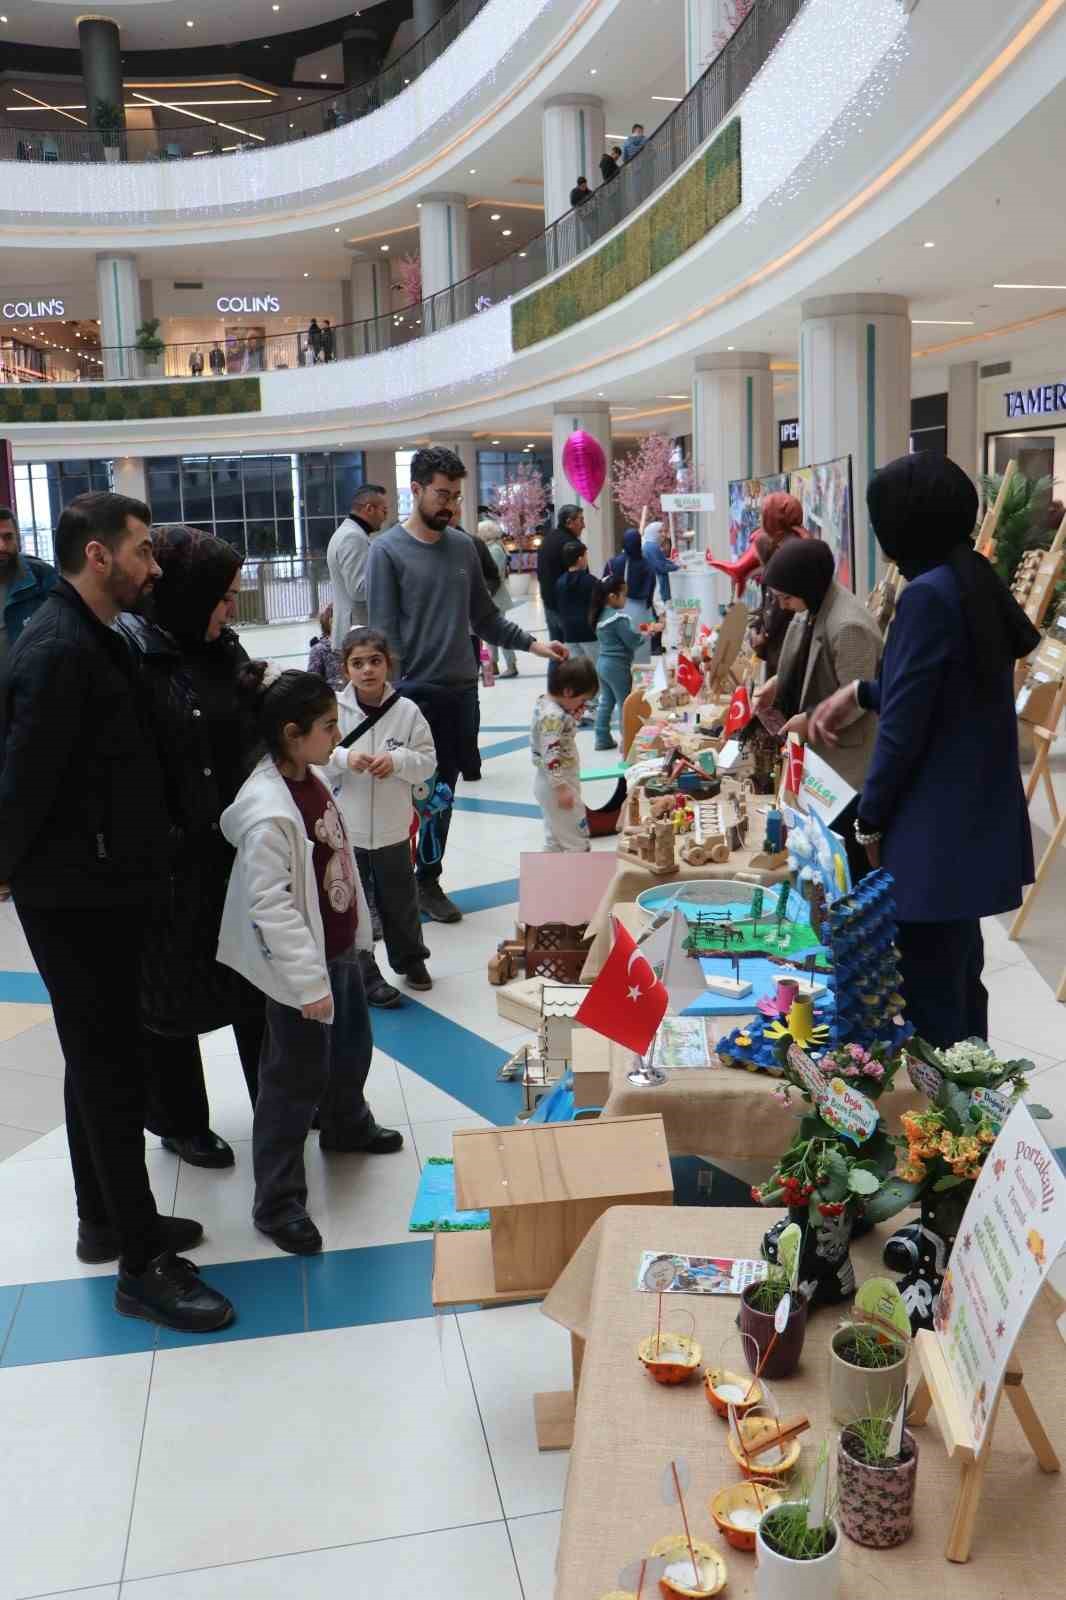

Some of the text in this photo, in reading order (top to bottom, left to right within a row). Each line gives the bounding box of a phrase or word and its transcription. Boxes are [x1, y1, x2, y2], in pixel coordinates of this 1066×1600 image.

[2, 298, 65, 319] COLIN'S
[216, 295, 280, 313] COLIN'S
[1003, 383, 1066, 417] TAMER
